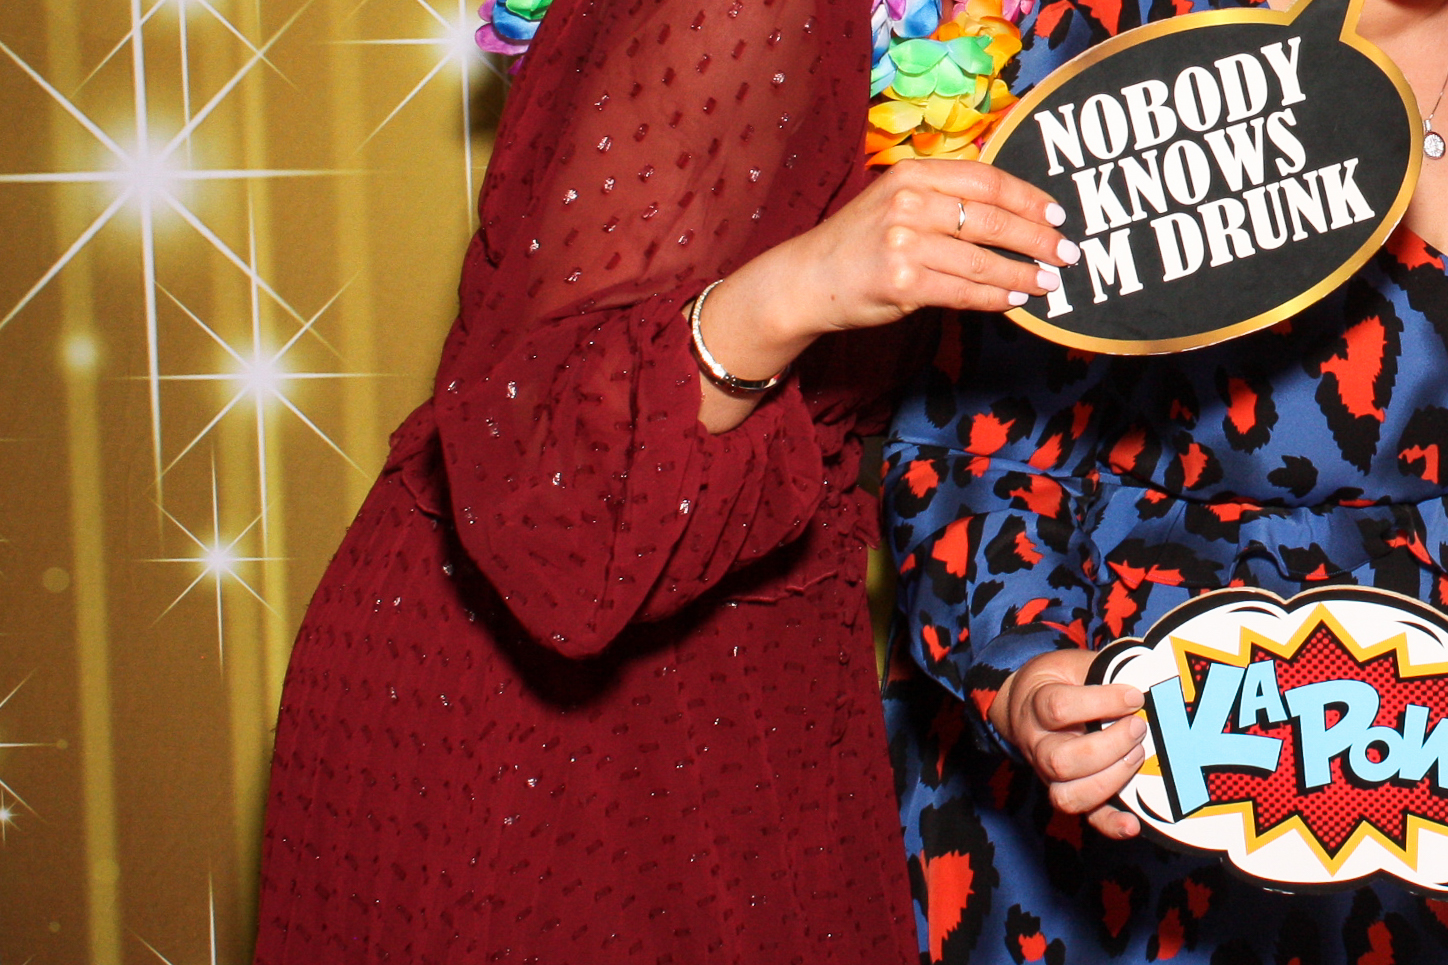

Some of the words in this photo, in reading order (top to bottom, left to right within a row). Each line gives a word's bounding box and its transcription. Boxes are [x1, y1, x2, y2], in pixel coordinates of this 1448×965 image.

[1033, 36, 1306, 177] NOBODY
[1071, 107, 1307, 236] KNOWS
[1034, 228, 1144, 319] IM
[1150, 157, 1376, 282] DRUNK
